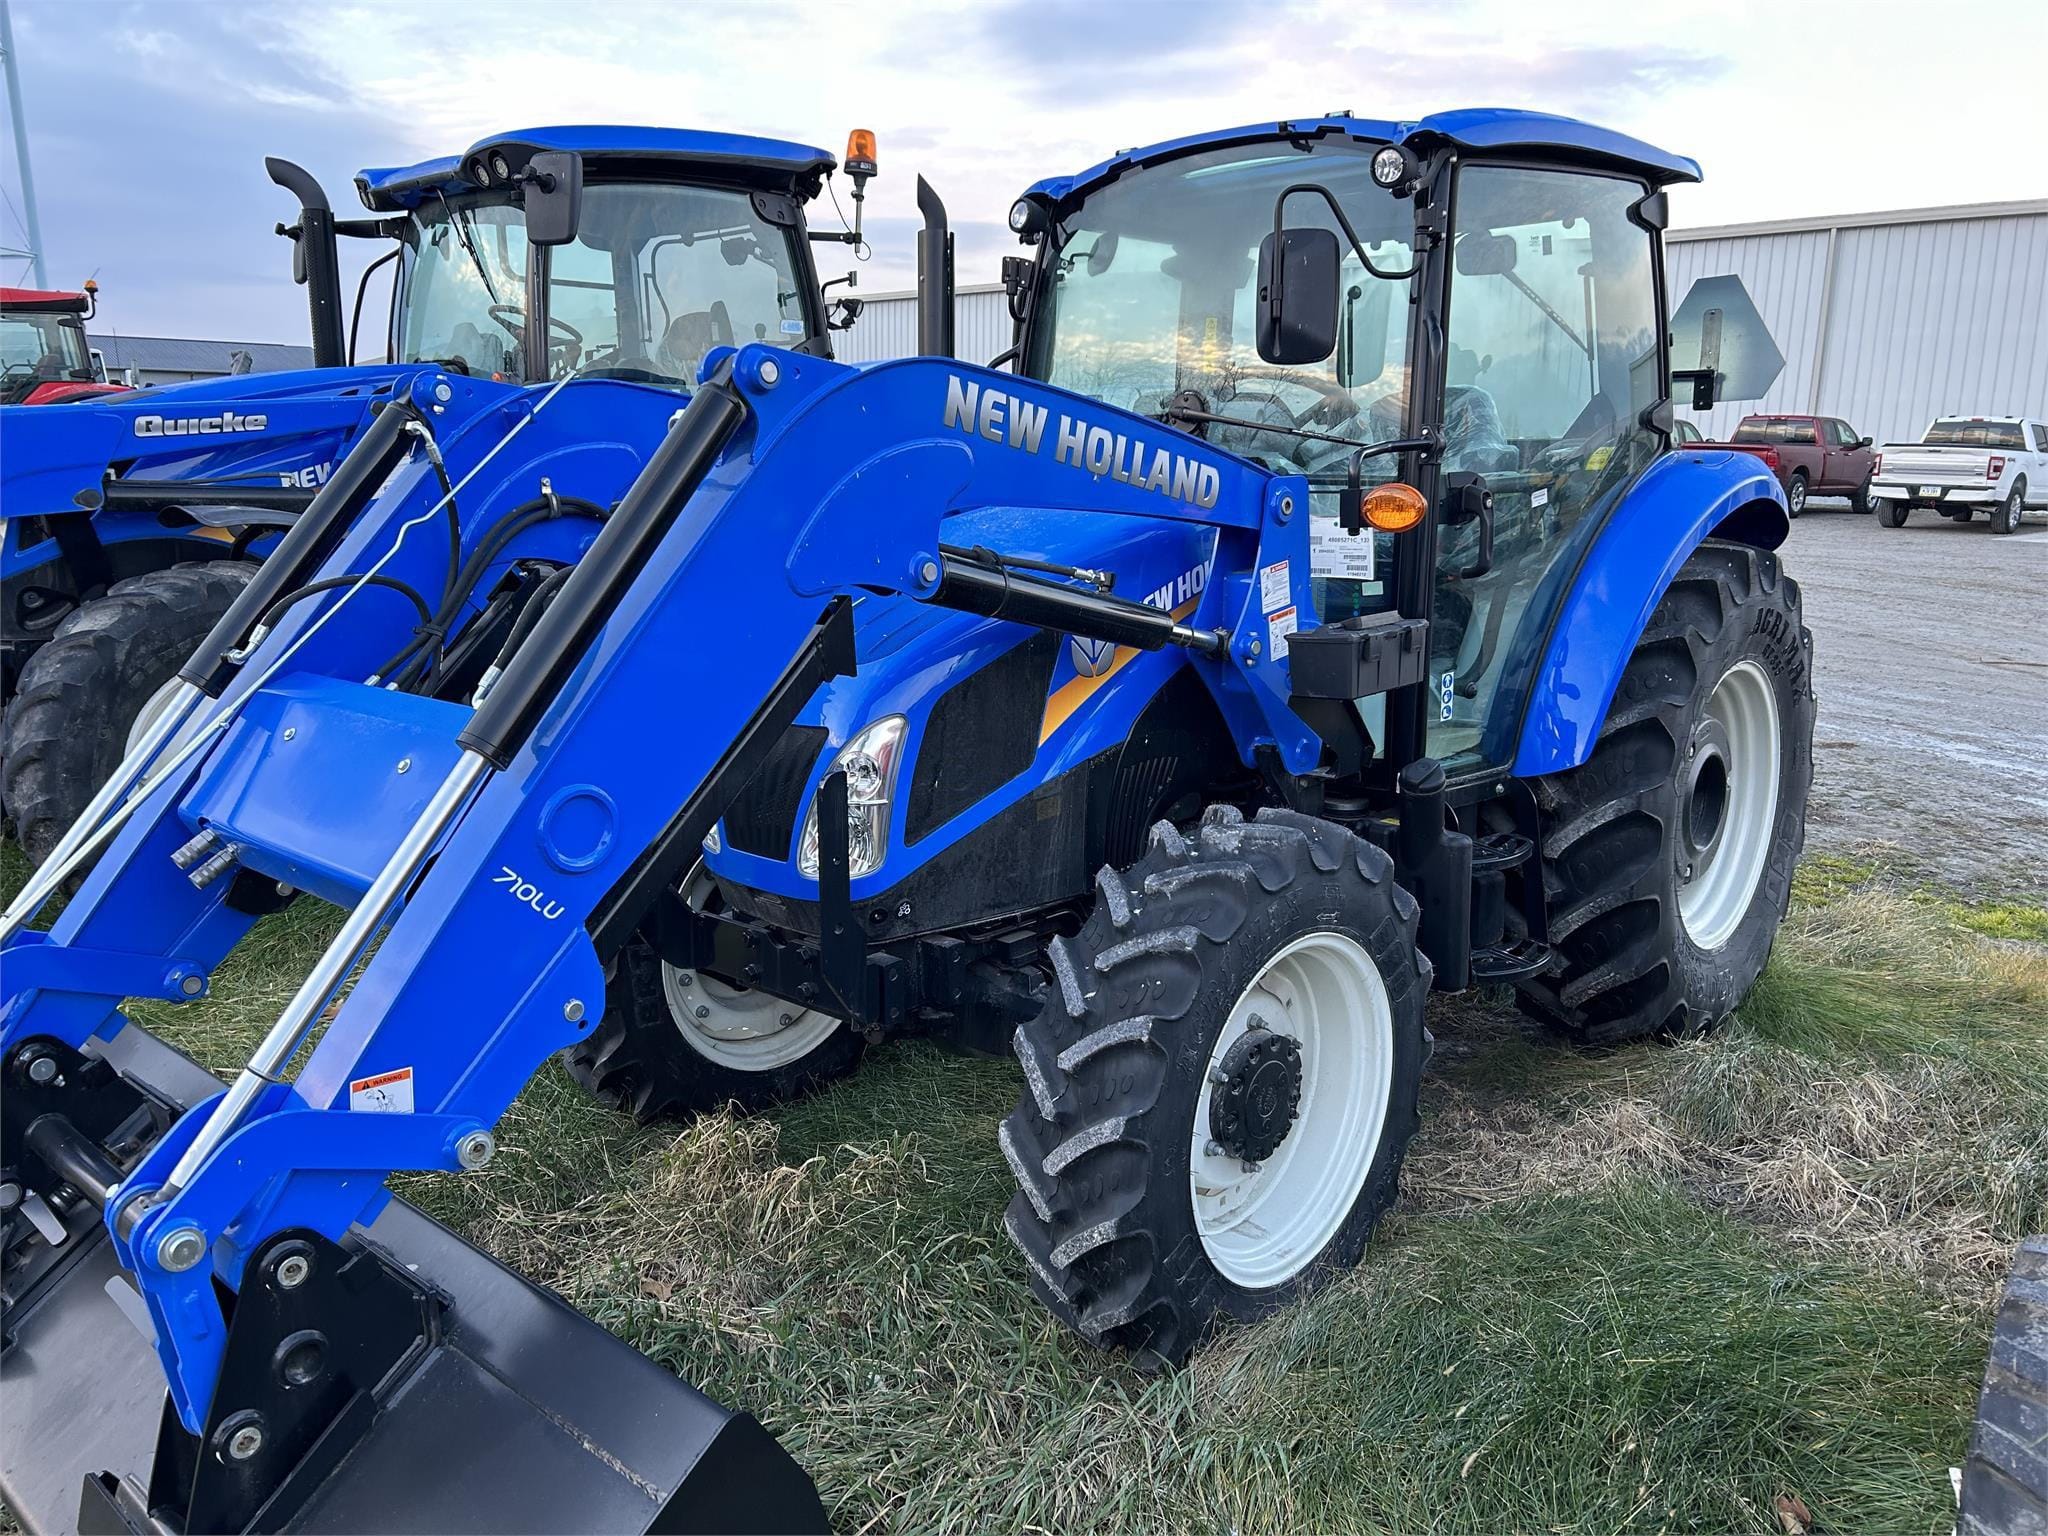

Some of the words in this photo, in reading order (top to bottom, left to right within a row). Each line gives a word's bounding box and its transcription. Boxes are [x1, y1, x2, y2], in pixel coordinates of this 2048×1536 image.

[134, 411, 268, 438] Quicke
[943, 374, 1049, 454] NEW
[1055, 414, 1220, 509] HOLLAND
[492, 866, 565, 919] 710LU
[373, 1074, 402, 1086] WARNING
